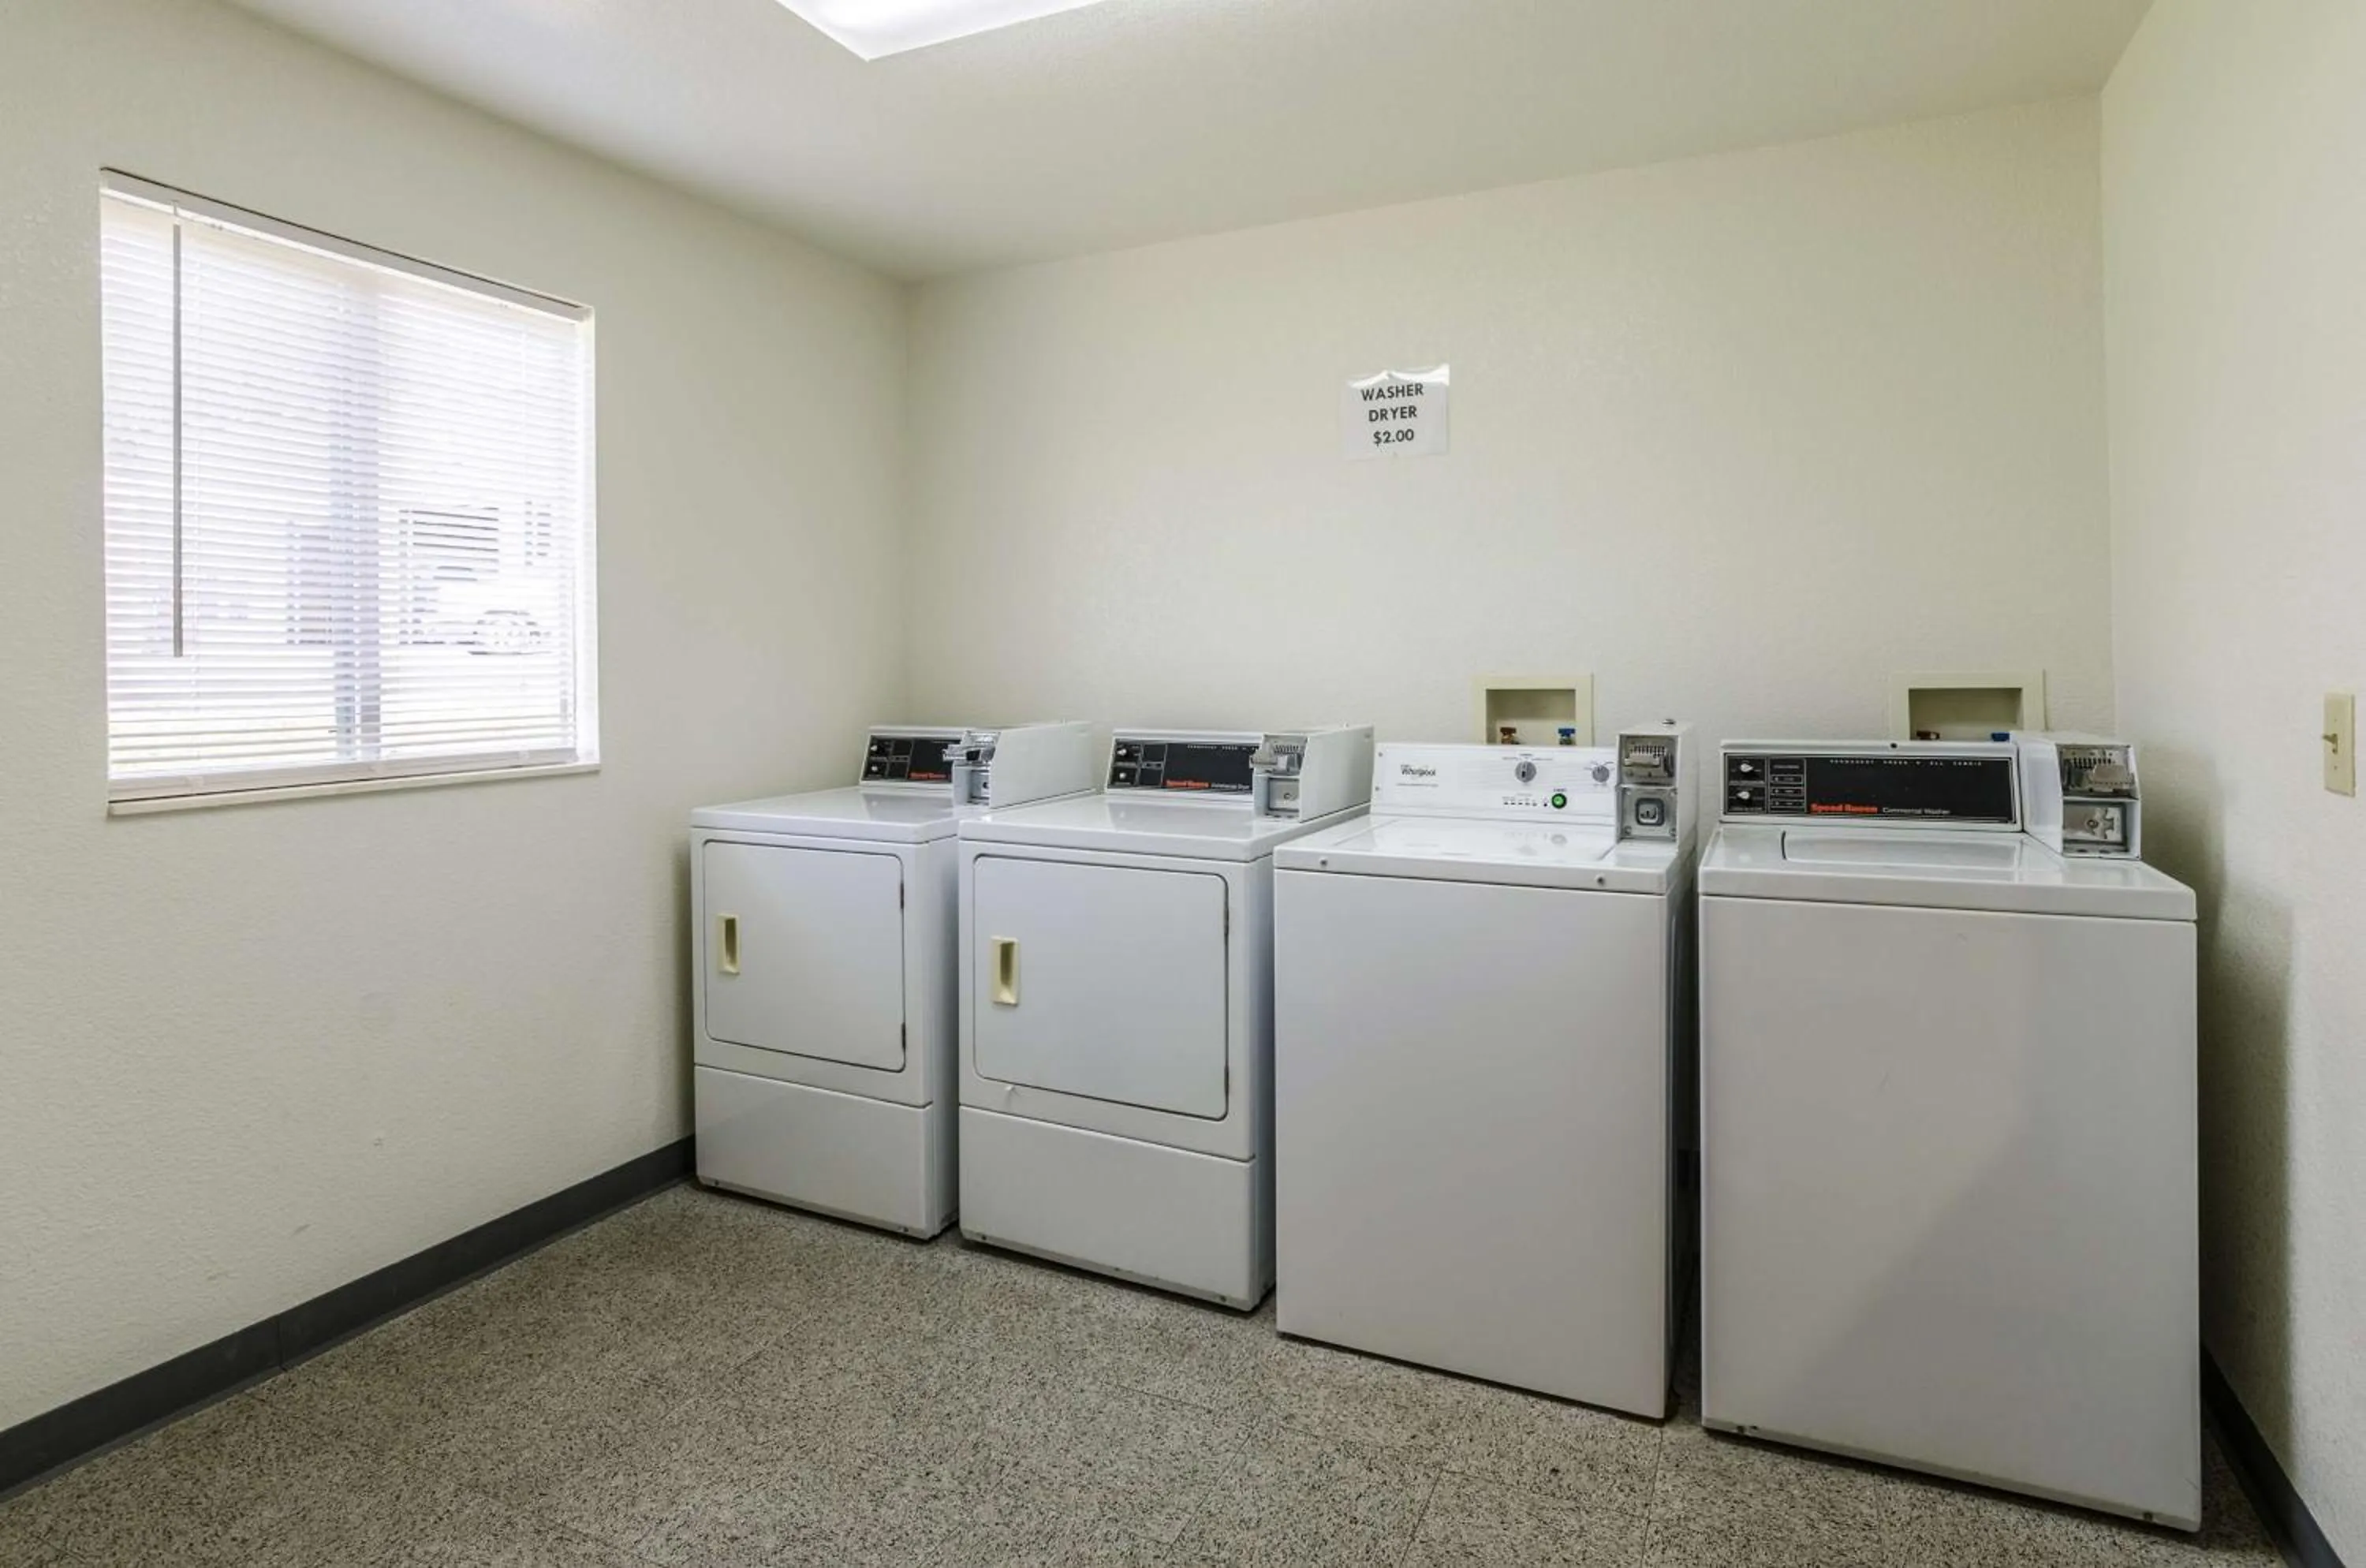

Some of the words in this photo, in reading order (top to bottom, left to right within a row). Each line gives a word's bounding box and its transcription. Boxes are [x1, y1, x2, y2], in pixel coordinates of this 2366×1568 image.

[1360, 383, 1424, 401] WASHER
[1368, 405, 1417, 422] DRYER
[1373, 428, 1414, 446] $2.00
